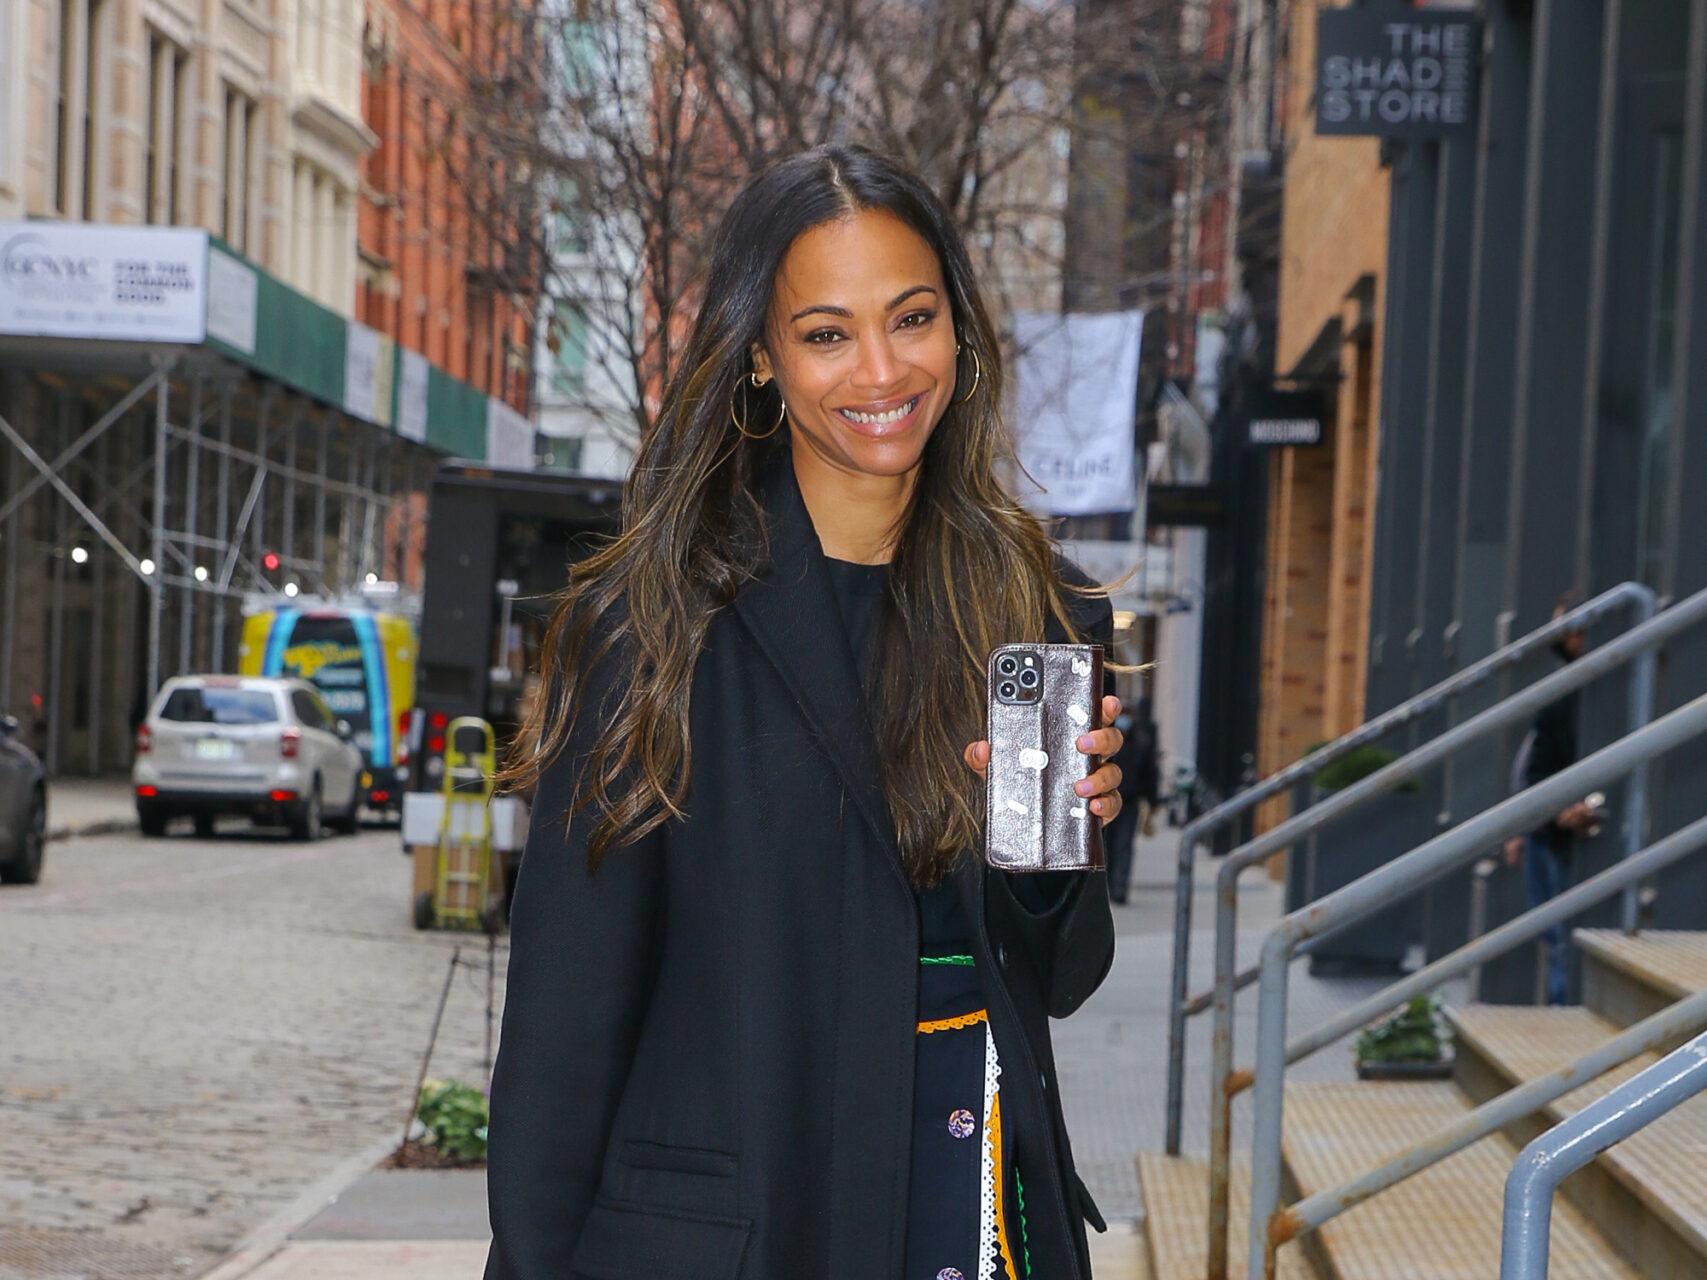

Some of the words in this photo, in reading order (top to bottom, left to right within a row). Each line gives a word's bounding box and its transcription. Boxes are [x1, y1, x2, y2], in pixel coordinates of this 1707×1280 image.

[1384, 23, 1470, 56] THE
[1323, 55, 1470, 90] SHADE
[1321, 89, 1467, 122] STORE
[114, 258, 149, 272] FOR
[155, 260, 189, 274] THE
